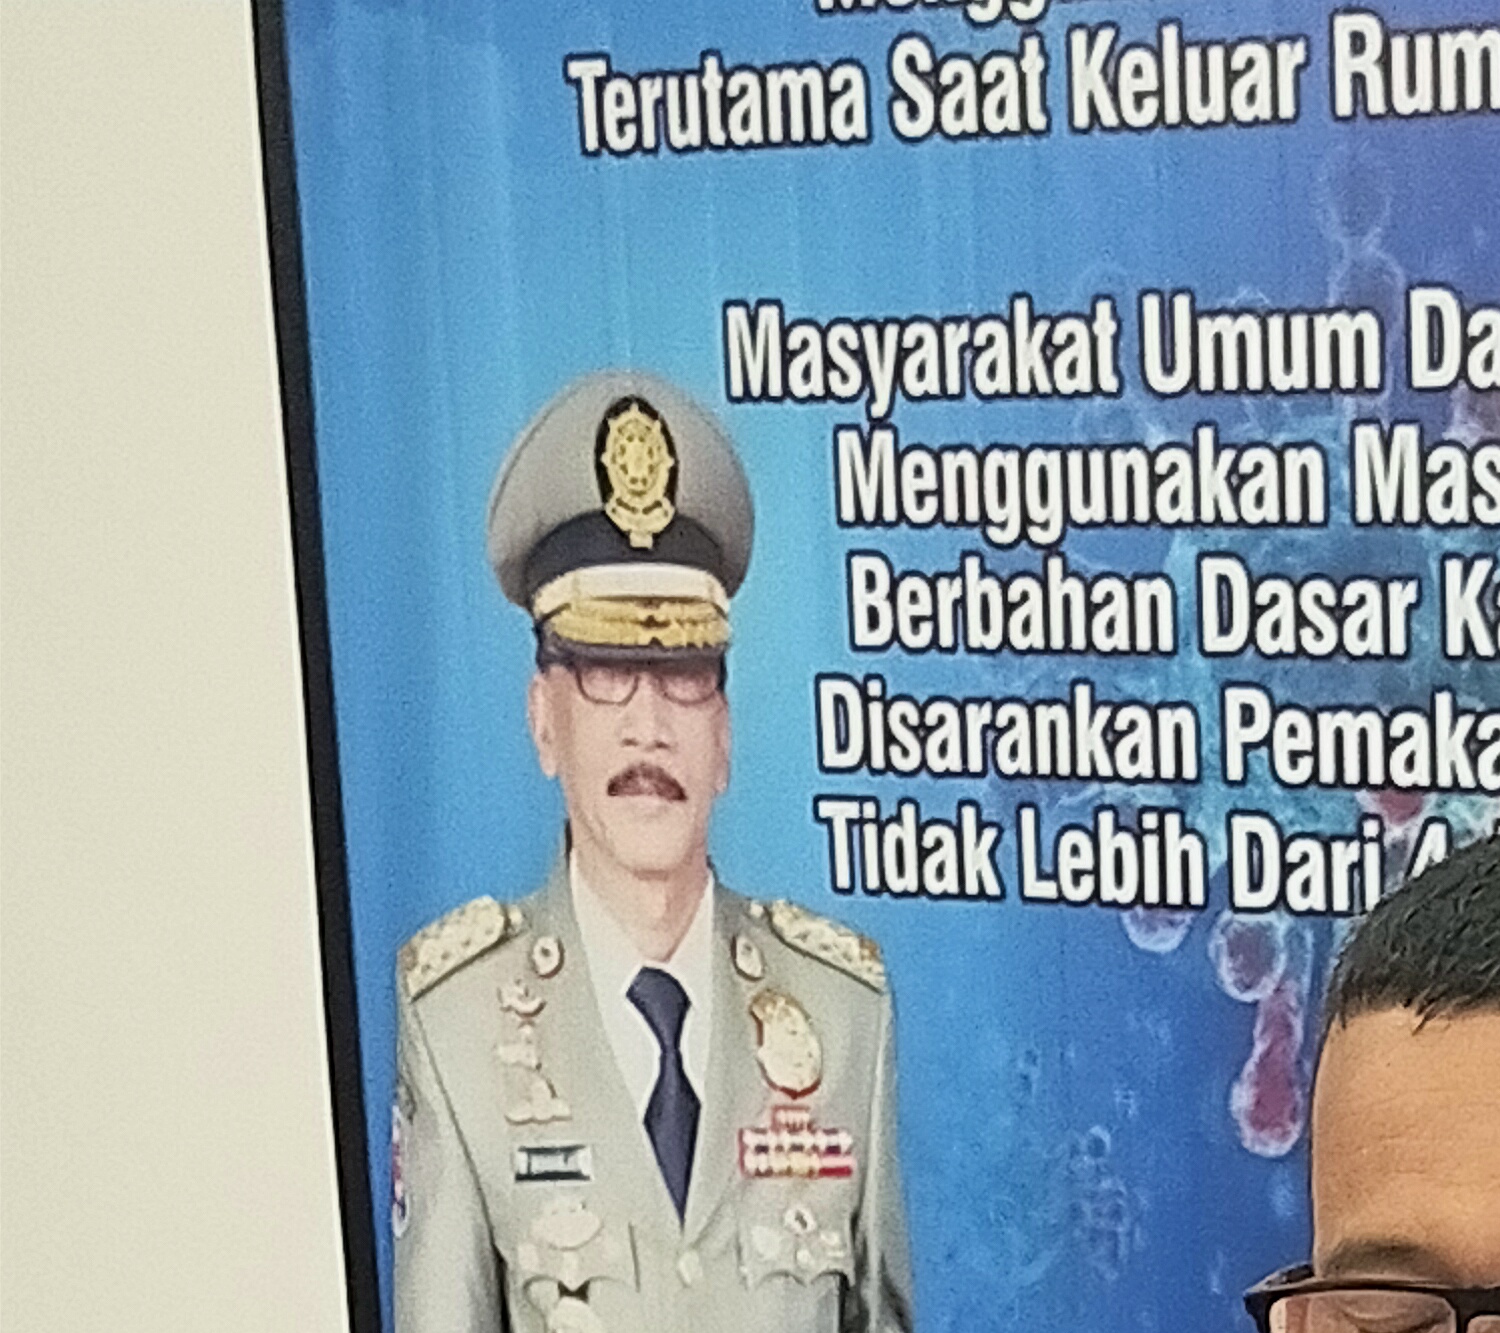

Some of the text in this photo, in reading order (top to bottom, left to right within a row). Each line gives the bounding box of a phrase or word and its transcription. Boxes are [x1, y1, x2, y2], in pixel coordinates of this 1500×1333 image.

[568, 55, 868, 153] Terutama
[890, 36, 1046, 141] Saat
[1069, 20, 1308, 131] Keluar
[724, 297, 1120, 415] Masyarakat
[1141, 292, 1382, 396] Umum
[835, 426, 1326, 545] Menggunakan
[848, 551, 1177, 654] Berbahan
[1201, 556, 1417, 657] Dasar
[814, 676, 1198, 782] Disarankan
[814, 797, 1003, 898] Tidak
[1020, 809, 1205, 910] Lebih
[1230, 814, 1386, 915] Dari
